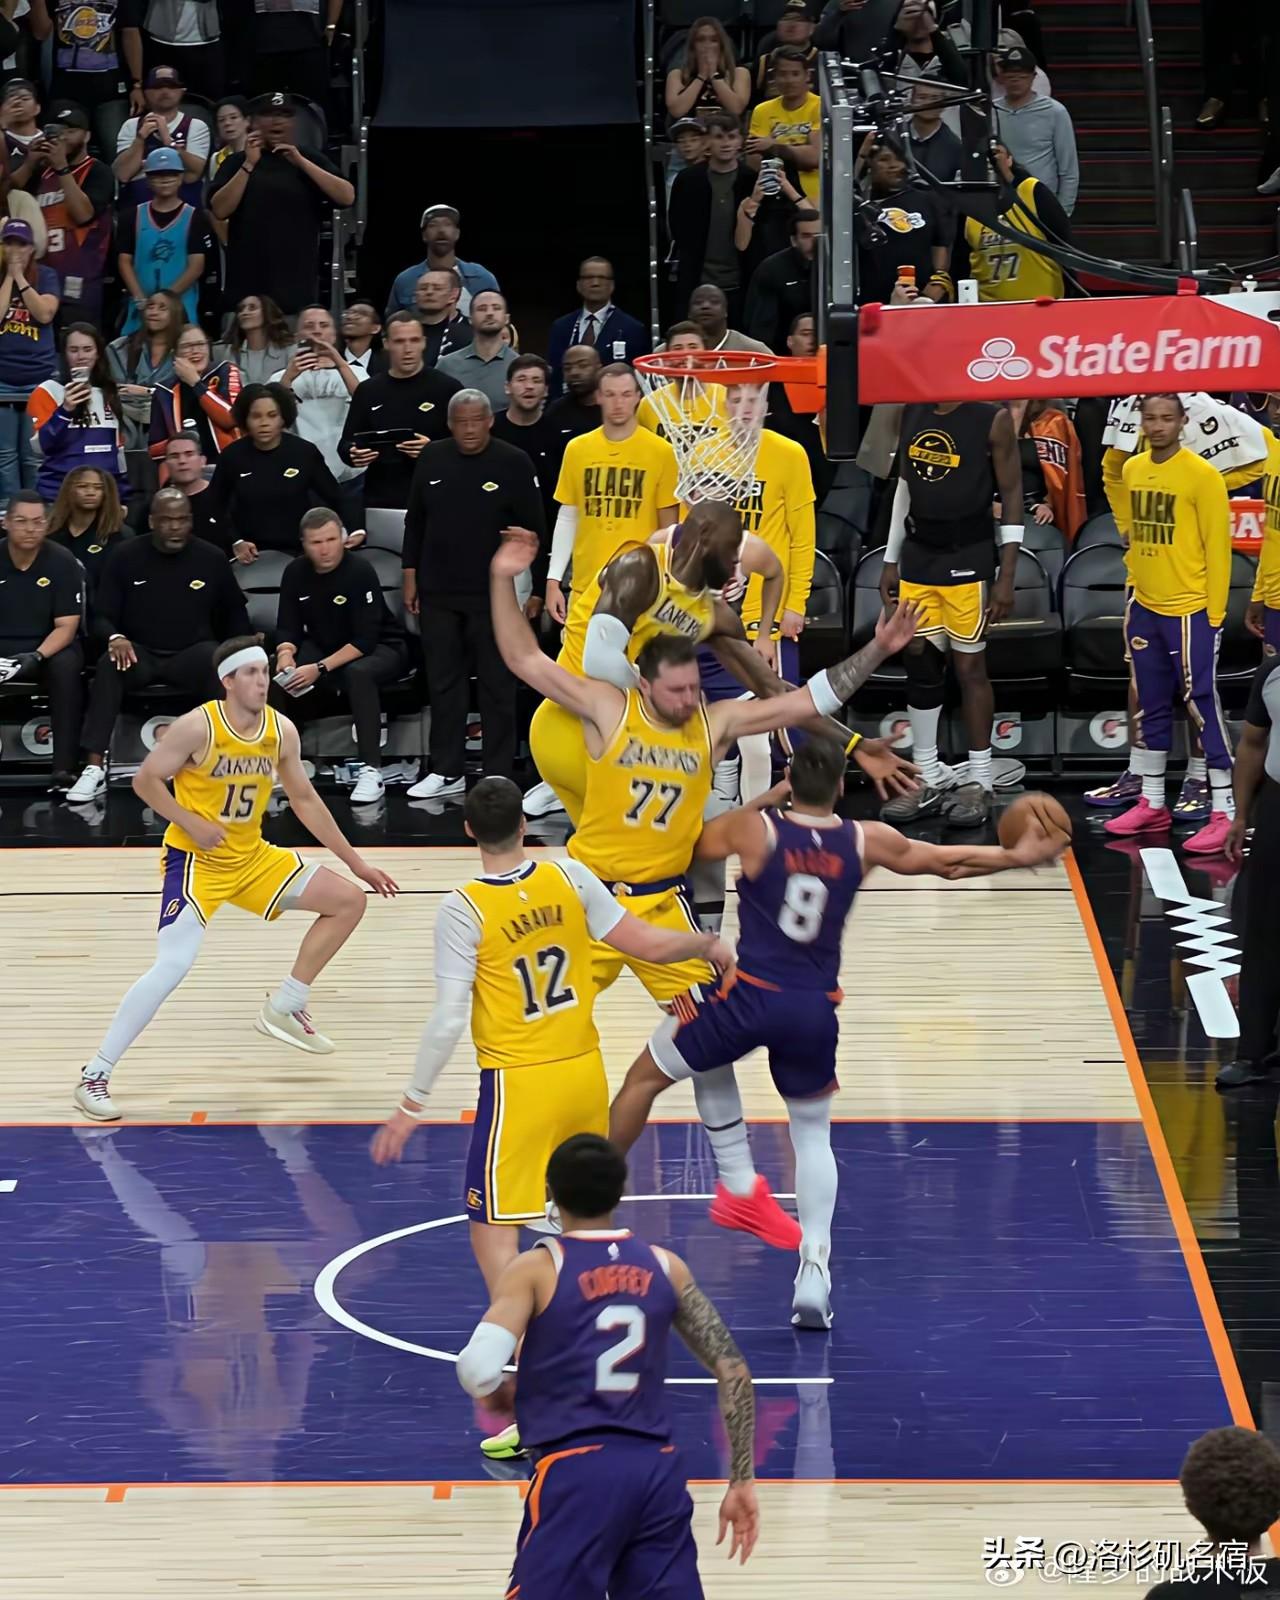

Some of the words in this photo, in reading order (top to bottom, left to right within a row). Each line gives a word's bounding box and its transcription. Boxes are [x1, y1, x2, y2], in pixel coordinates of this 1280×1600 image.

[988, 252, 1020, 283] 77
[584, 467, 646, 499] BLACK
[219, 783, 258, 821] 15
[624, 776, 684, 831] 77
[777, 872, 830, 943] 8
[513, 945, 579, 1023] 12
[595, 1304, 646, 1392] 2
